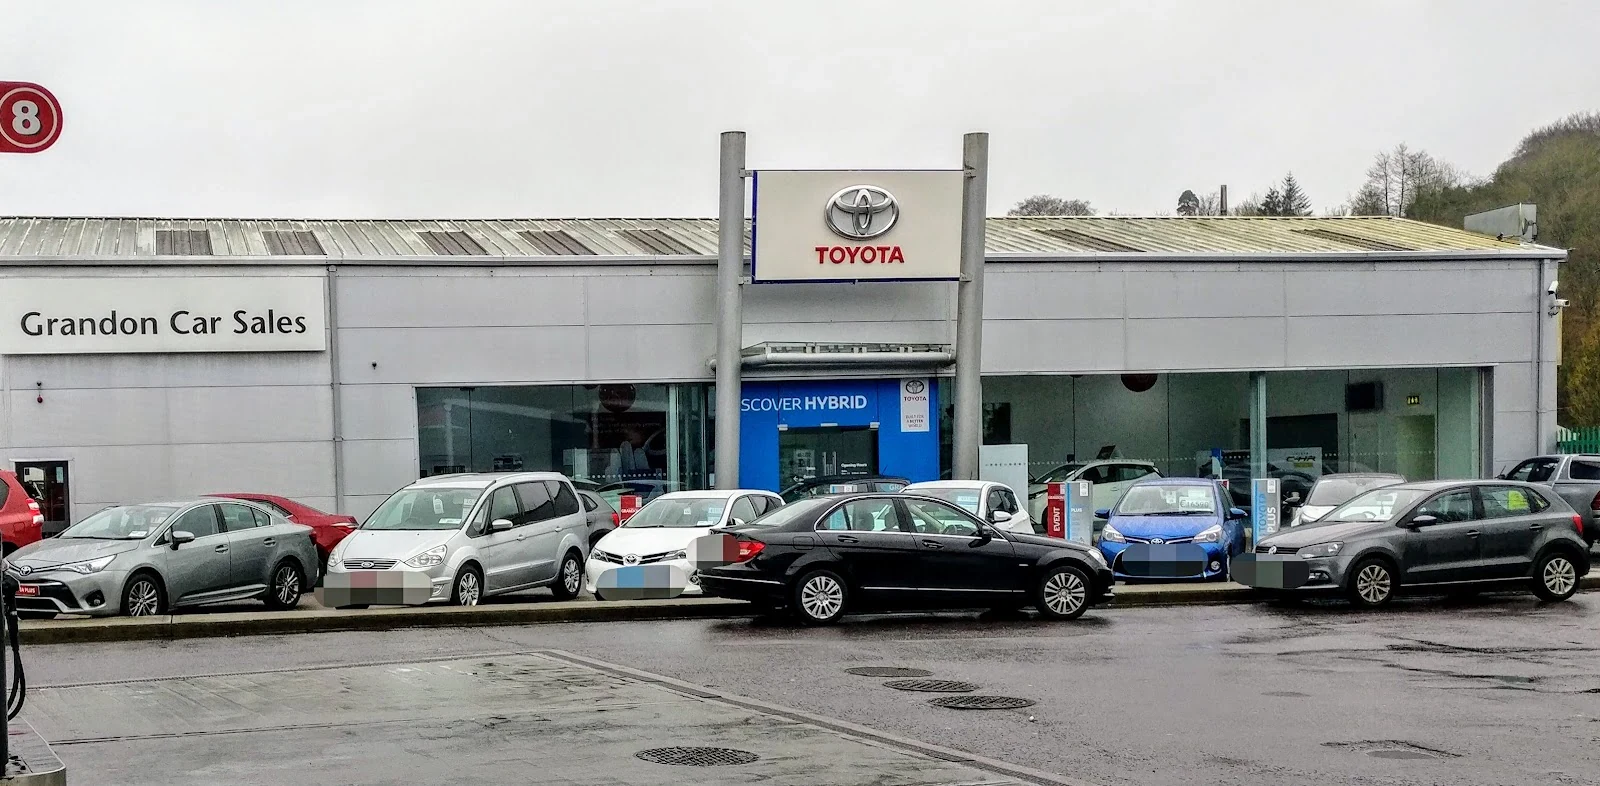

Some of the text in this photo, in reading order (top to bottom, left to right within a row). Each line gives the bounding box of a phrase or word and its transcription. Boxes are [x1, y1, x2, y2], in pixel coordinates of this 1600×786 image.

[12, 100, 41, 135] 8
[815, 246, 905, 264] TOYOTA
[20, 309, 307, 336] Grandon Car Sales
[741, 395, 868, 411] SCOVER HYBRID
[1053, 507, 1061, 532] EVENT
[1267, 506, 1276, 533] PLUS
